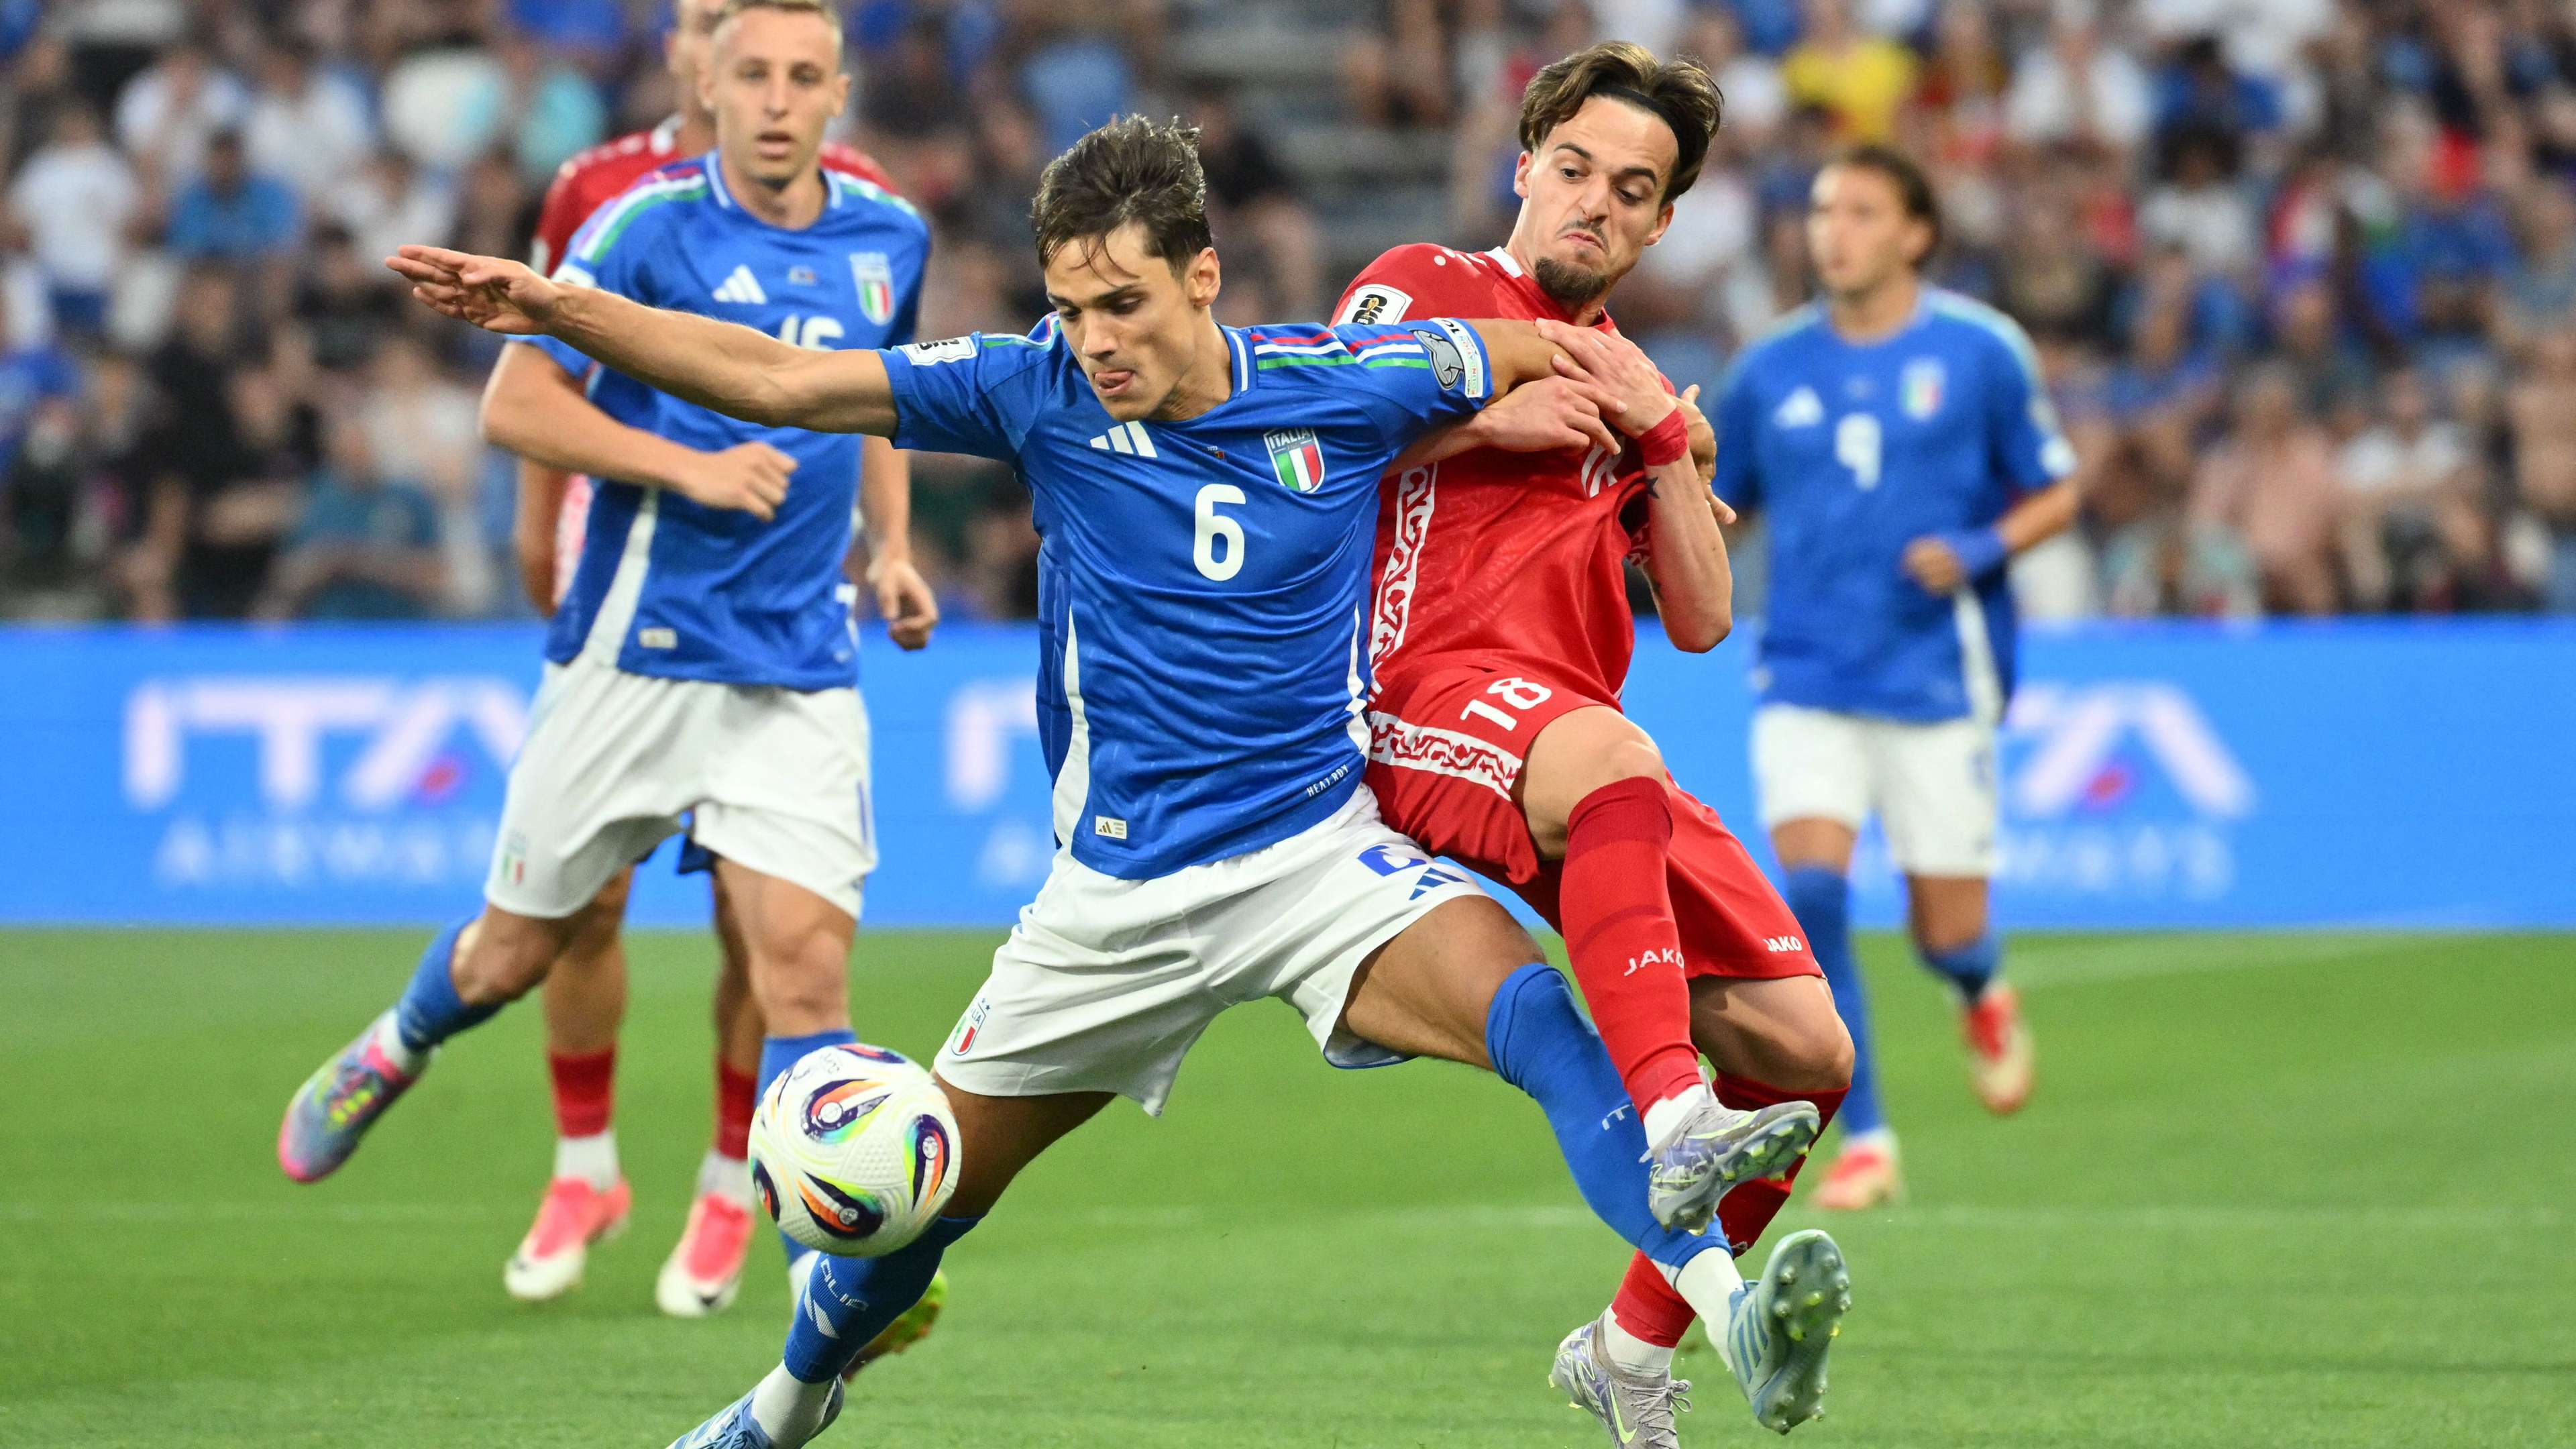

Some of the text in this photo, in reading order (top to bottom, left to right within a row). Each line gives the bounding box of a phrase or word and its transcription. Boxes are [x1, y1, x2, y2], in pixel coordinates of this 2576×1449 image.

[1268, 427, 1311, 450] ITALIA
[1193, 483, 1246, 582] 6
[1460, 677, 1552, 731] 18
[1763, 935, 1803, 952] JAKO
[1623, 947, 1684, 977] JAKO
